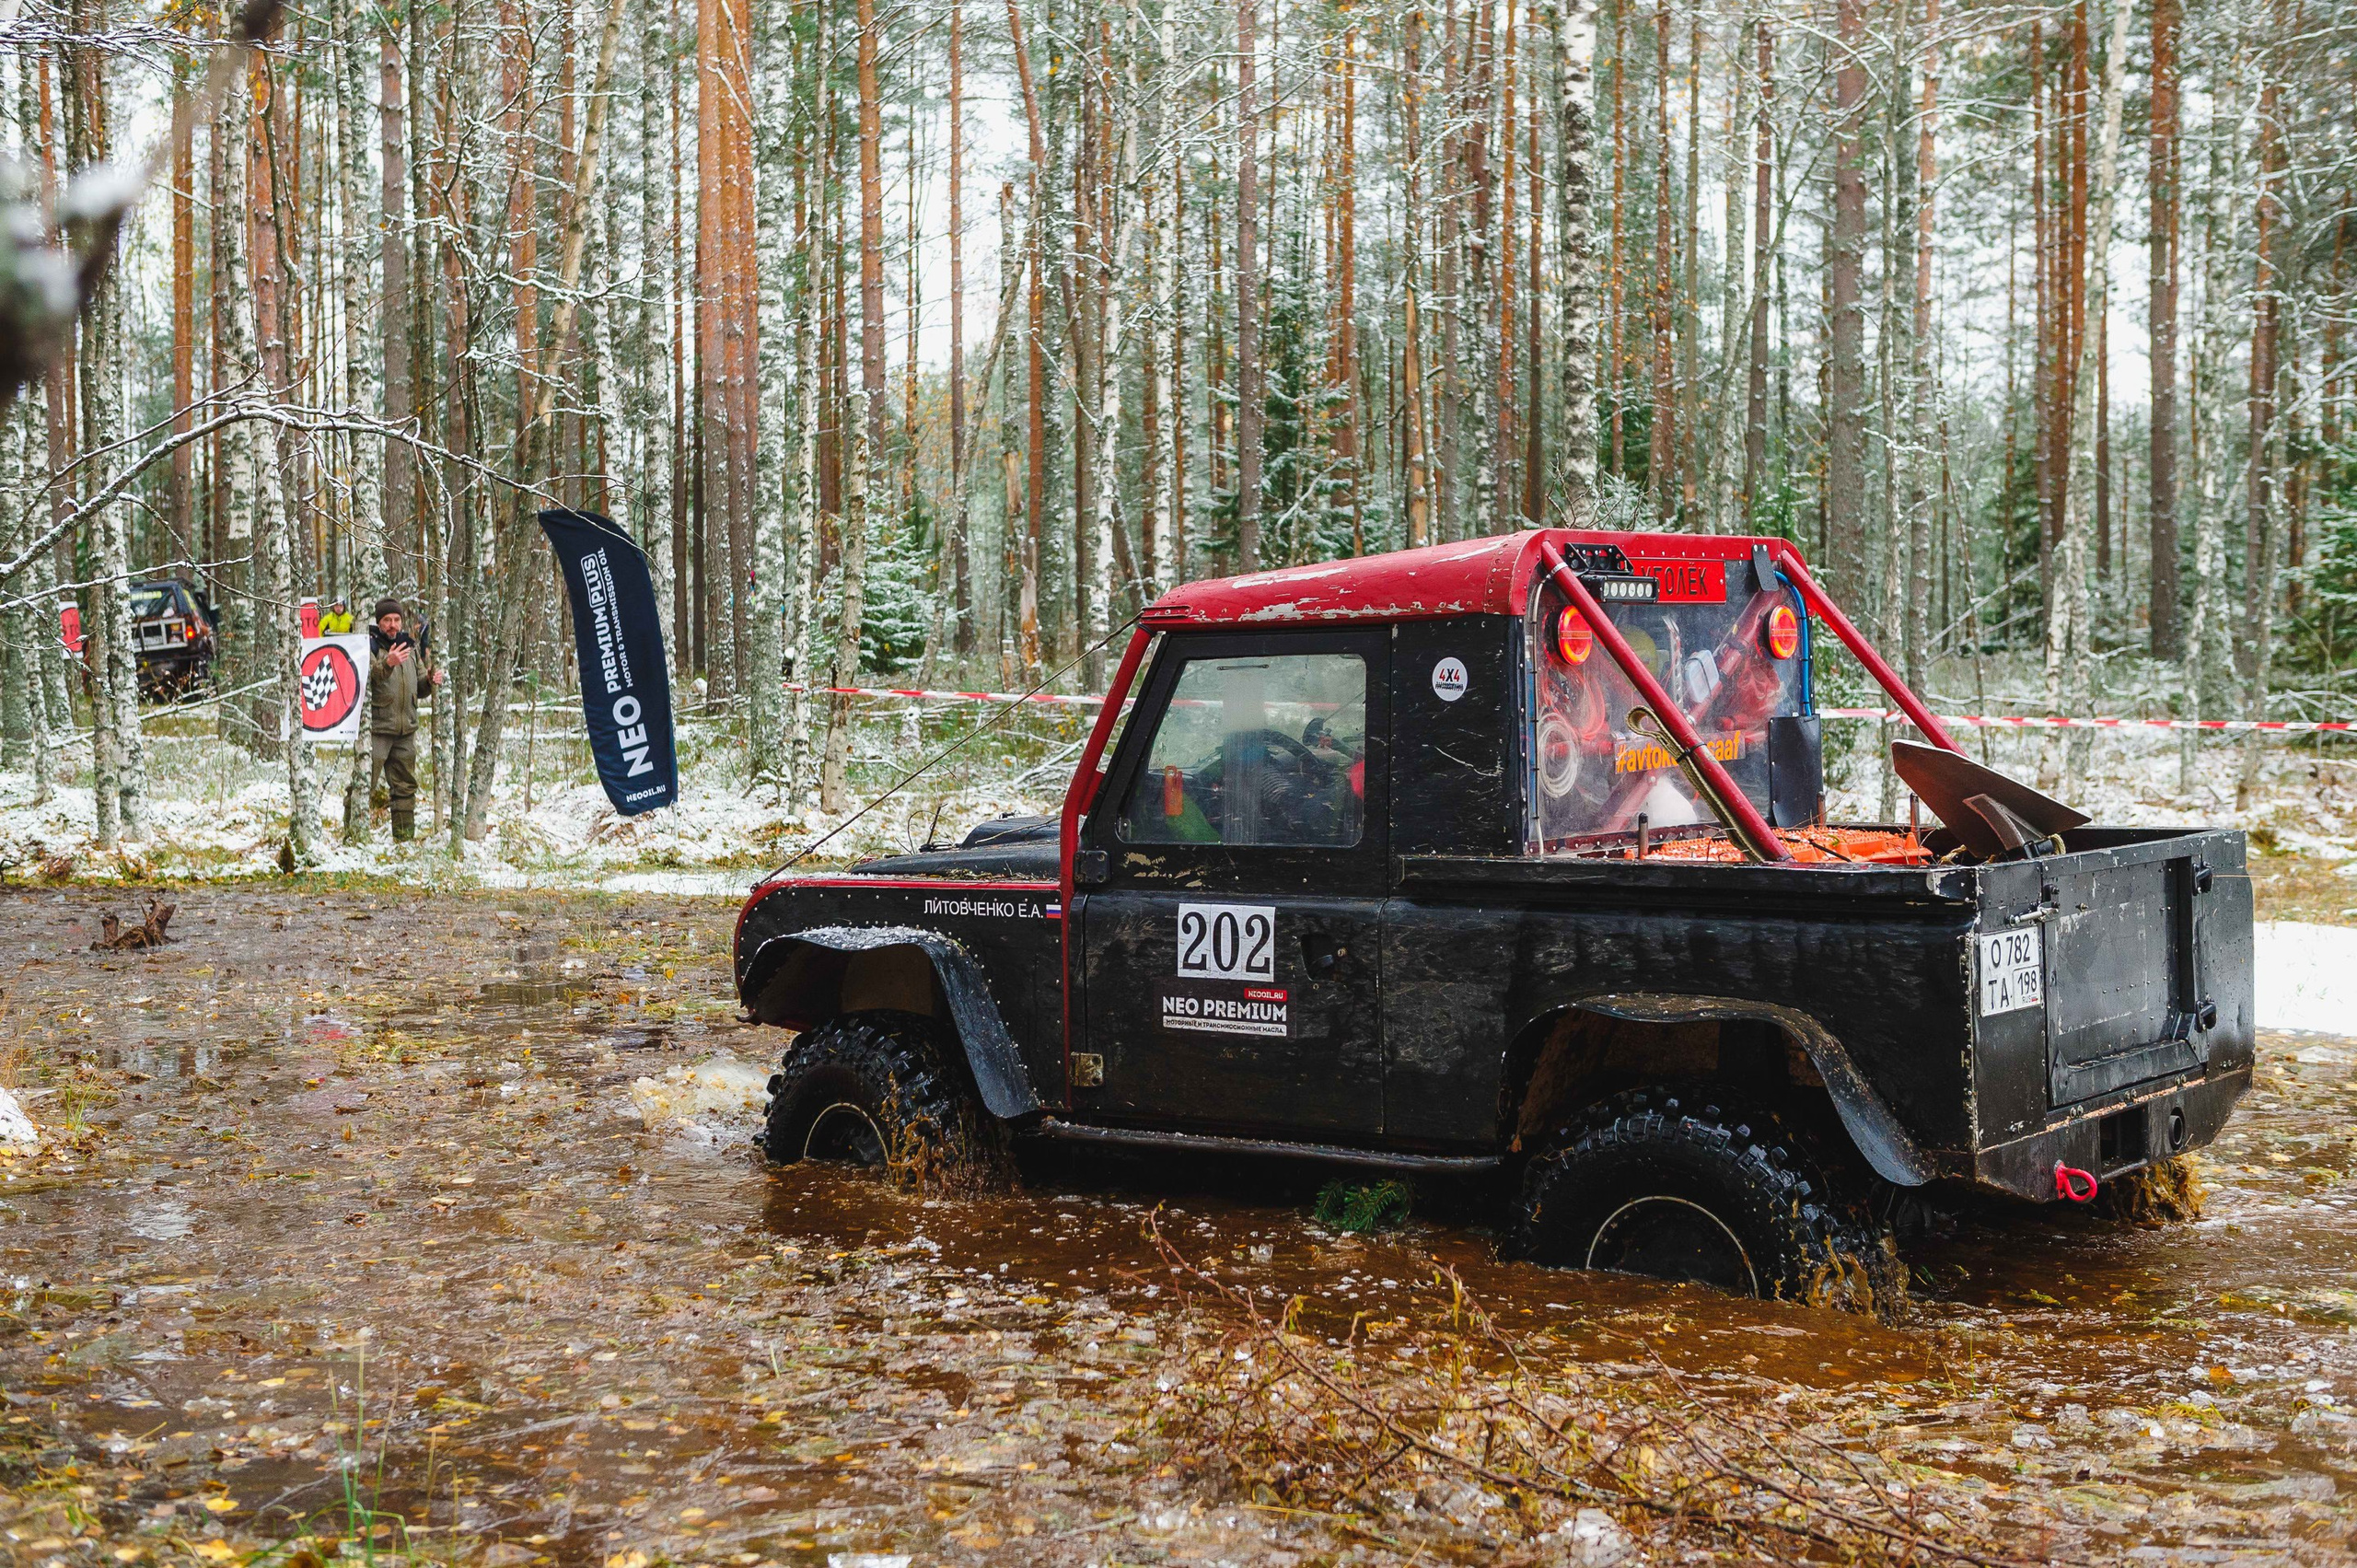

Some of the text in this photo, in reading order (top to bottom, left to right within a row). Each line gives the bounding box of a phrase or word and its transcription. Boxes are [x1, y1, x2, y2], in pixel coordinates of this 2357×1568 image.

[597, 547, 608, 565] OIL
[602, 565, 623, 644] TRANSMISSION
[583, 557, 654, 778] NEO PREMIUM PLUS
[619, 651, 633, 688] MOTOR
[626, 784, 667, 803] NEOOIL.RU
[923, 900, 1044, 919] ЛИТОВЧЕНКО Е.А.
[1181, 911, 1271, 974] 202
[2005, 933, 2030, 966] 782
[1248, 990, 1284, 1000] NEOOIL.RU
[1988, 977, 2010, 1010] ТА
[2017, 970, 2038, 995] 198
[1162, 995, 1287, 1022] NEO PREMIUM
[1166, 1019, 1197, 1028] МОТОРНЫЕ
[1202, 1022, 1262, 1032] ТРАНСМИССИОННЫЕ
